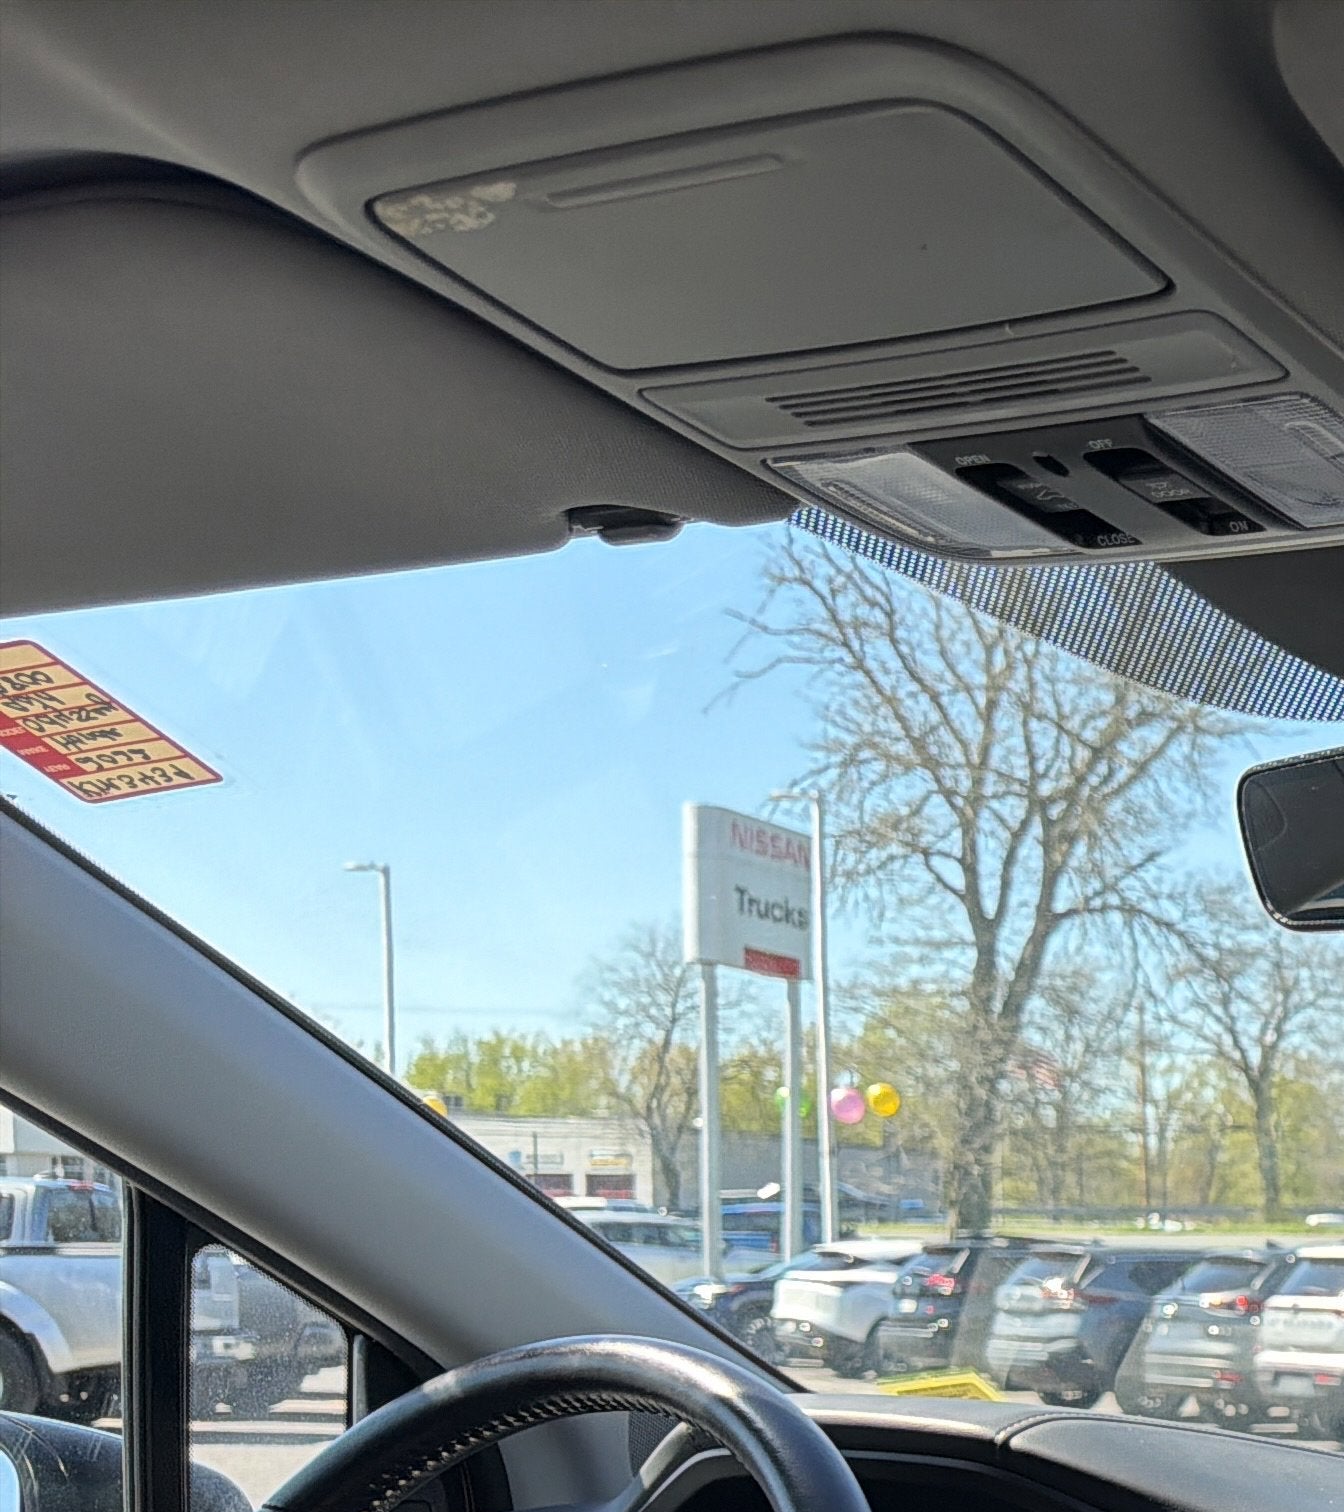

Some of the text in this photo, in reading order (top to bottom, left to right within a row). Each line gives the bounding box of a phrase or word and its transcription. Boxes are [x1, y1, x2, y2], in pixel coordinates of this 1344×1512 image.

[1088, 438, 1113, 449] OFF
[955, 454, 991, 466] OPEN
[1229, 521, 1249, 533] ON
[1097, 533, 1136, 547] CLOSE
[730, 818, 811, 870] NISSAN
[735, 883, 810, 931] Trucks
